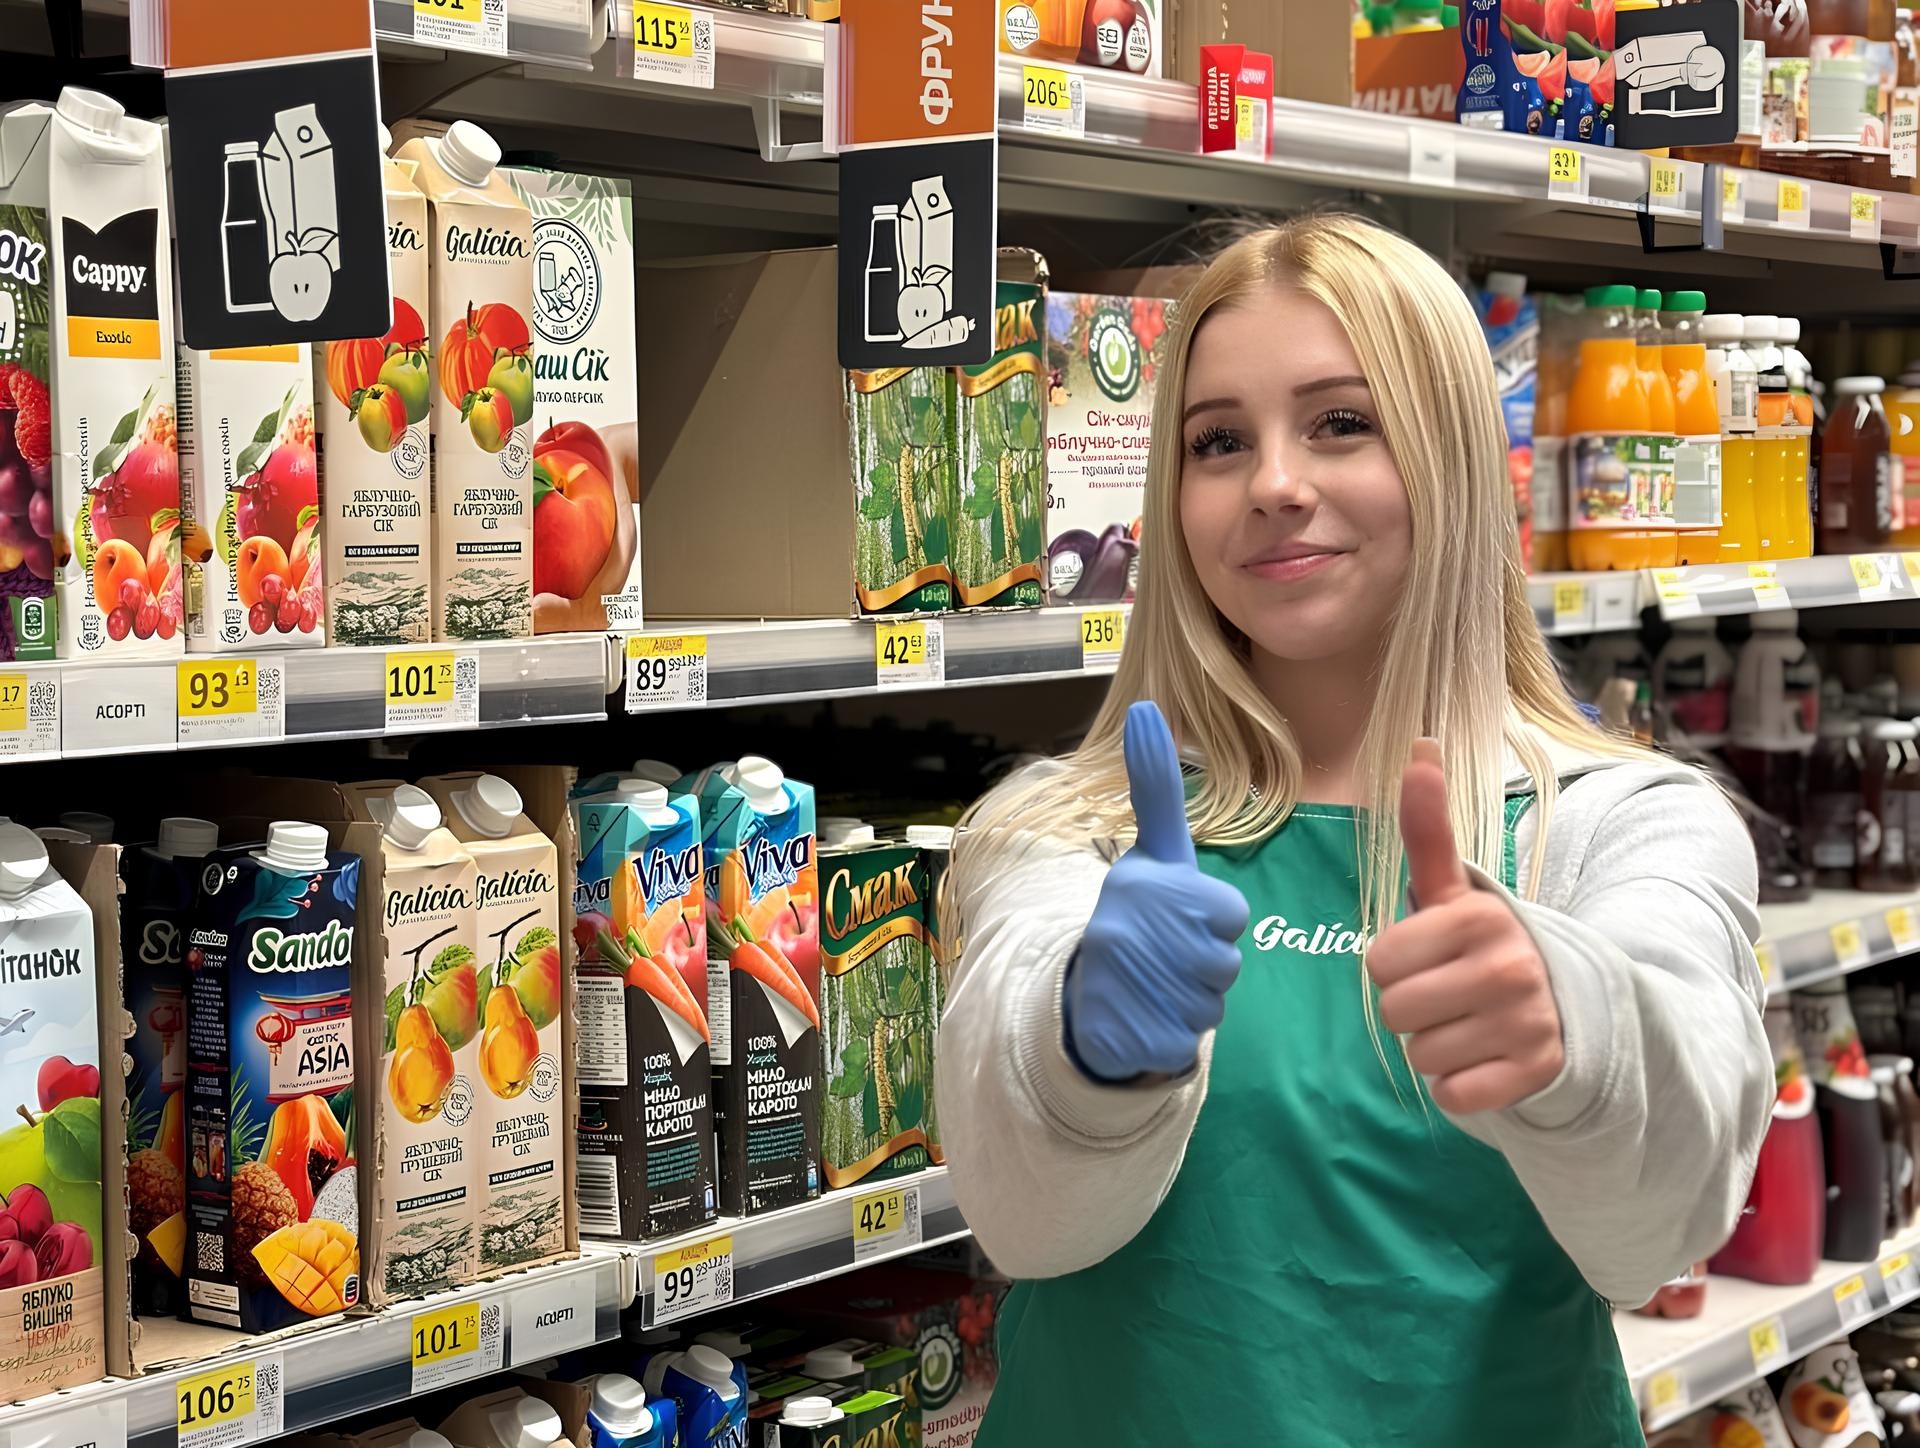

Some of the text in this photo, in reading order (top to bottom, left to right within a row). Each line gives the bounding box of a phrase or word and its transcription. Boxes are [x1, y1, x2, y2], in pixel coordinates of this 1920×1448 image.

[636, 15, 677, 49] 115
[1026, 78, 1057, 106] 206
[446, 225, 531, 261] Galicia
[72, 255, 147, 293] Cappy
[572, 347, 610, 381] Сік
[1084, 619, 1114, 643] 236
[883, 635, 909, 665] 42
[190, 672, 229, 709] 93
[389, 665, 437, 697] 101
[636, 658, 666, 690] 89
[96, 703, 146, 720] АСОРТІ
[632, 844, 701, 900] Viva
[740, 833, 814, 888] Viva
[388, 884, 474, 927] Galicia
[476, 868, 556, 911] Galicia
[825, 860, 918, 941] Смак
[249, 920, 354, 973] Sando
[297, 1042, 350, 1077] ASIA
[860, 1201, 886, 1232] 42
[22, 1281, 74, 1312] ЯБЛУКО
[664, 1266, 693, 1303] 99
[23, 1303, 73, 1332] ВИШНЯ
[415, 1320, 461, 1358] 101
[180, 1375, 250, 1425] 106 75
